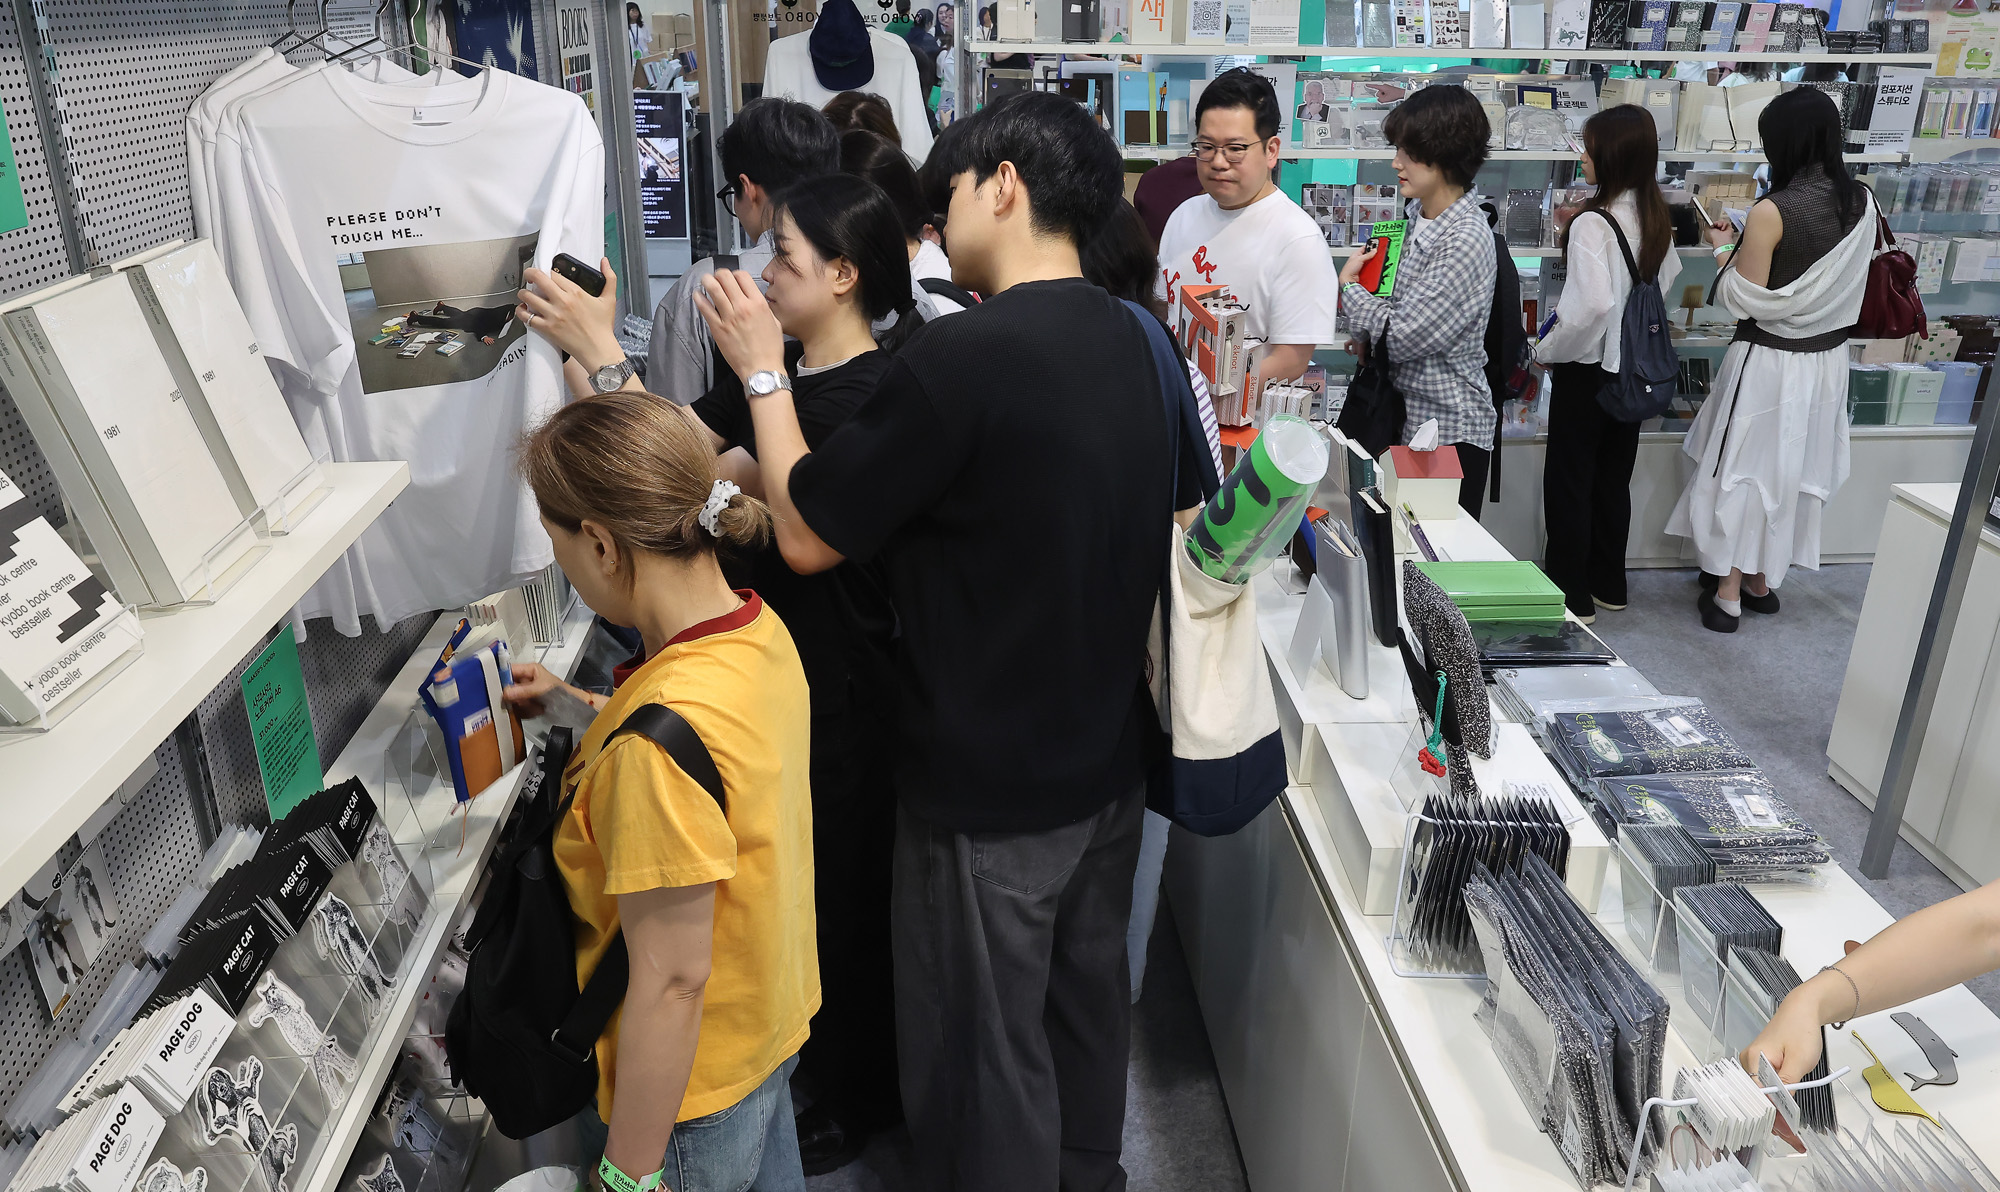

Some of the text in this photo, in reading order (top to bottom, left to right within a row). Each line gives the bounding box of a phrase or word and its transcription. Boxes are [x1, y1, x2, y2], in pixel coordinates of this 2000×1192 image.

[562, 7, 589, 49] BOOKS
[1880, 84, 1913, 94] 컴포지션
[1557, 101, 1589, 109] 프로젝트
[1877, 96, 1910, 105] 스튜디오
[327, 206, 441, 227] PLEASE DON'T
[331, 228, 423, 245] TOUCH ME...
[25, 329, 33, 341] book
[248, 342, 259, 355] 2025
[202, 369, 216, 383] 1981
[169, 388, 182, 403] 2025
[103, 424, 121, 440] 1981
[10, 558, 38, 579] centre
[0, 572, 76, 628] kyobo book centre
[9, 606, 53, 639] bestseller
[59, 649, 82, 669] book
[81, 630, 107, 653] centre
[42, 666, 83, 702] bestseller
[275, 684, 283, 698] A6
[338, 791, 359, 830] PAGE CAT
[280, 855, 309, 898] PAGE CAT
[222, 925, 255, 975] PAGE CAT
[159, 1002, 203, 1062] PAGE DOG
[188, 1034, 198, 1049] WOOF!
[211, 1037, 219, 1045] page
[90, 1101, 133, 1173] PAGE DOG
[119, 1139, 129, 1156] WOOF!
[140, 1141, 148, 1151] page
